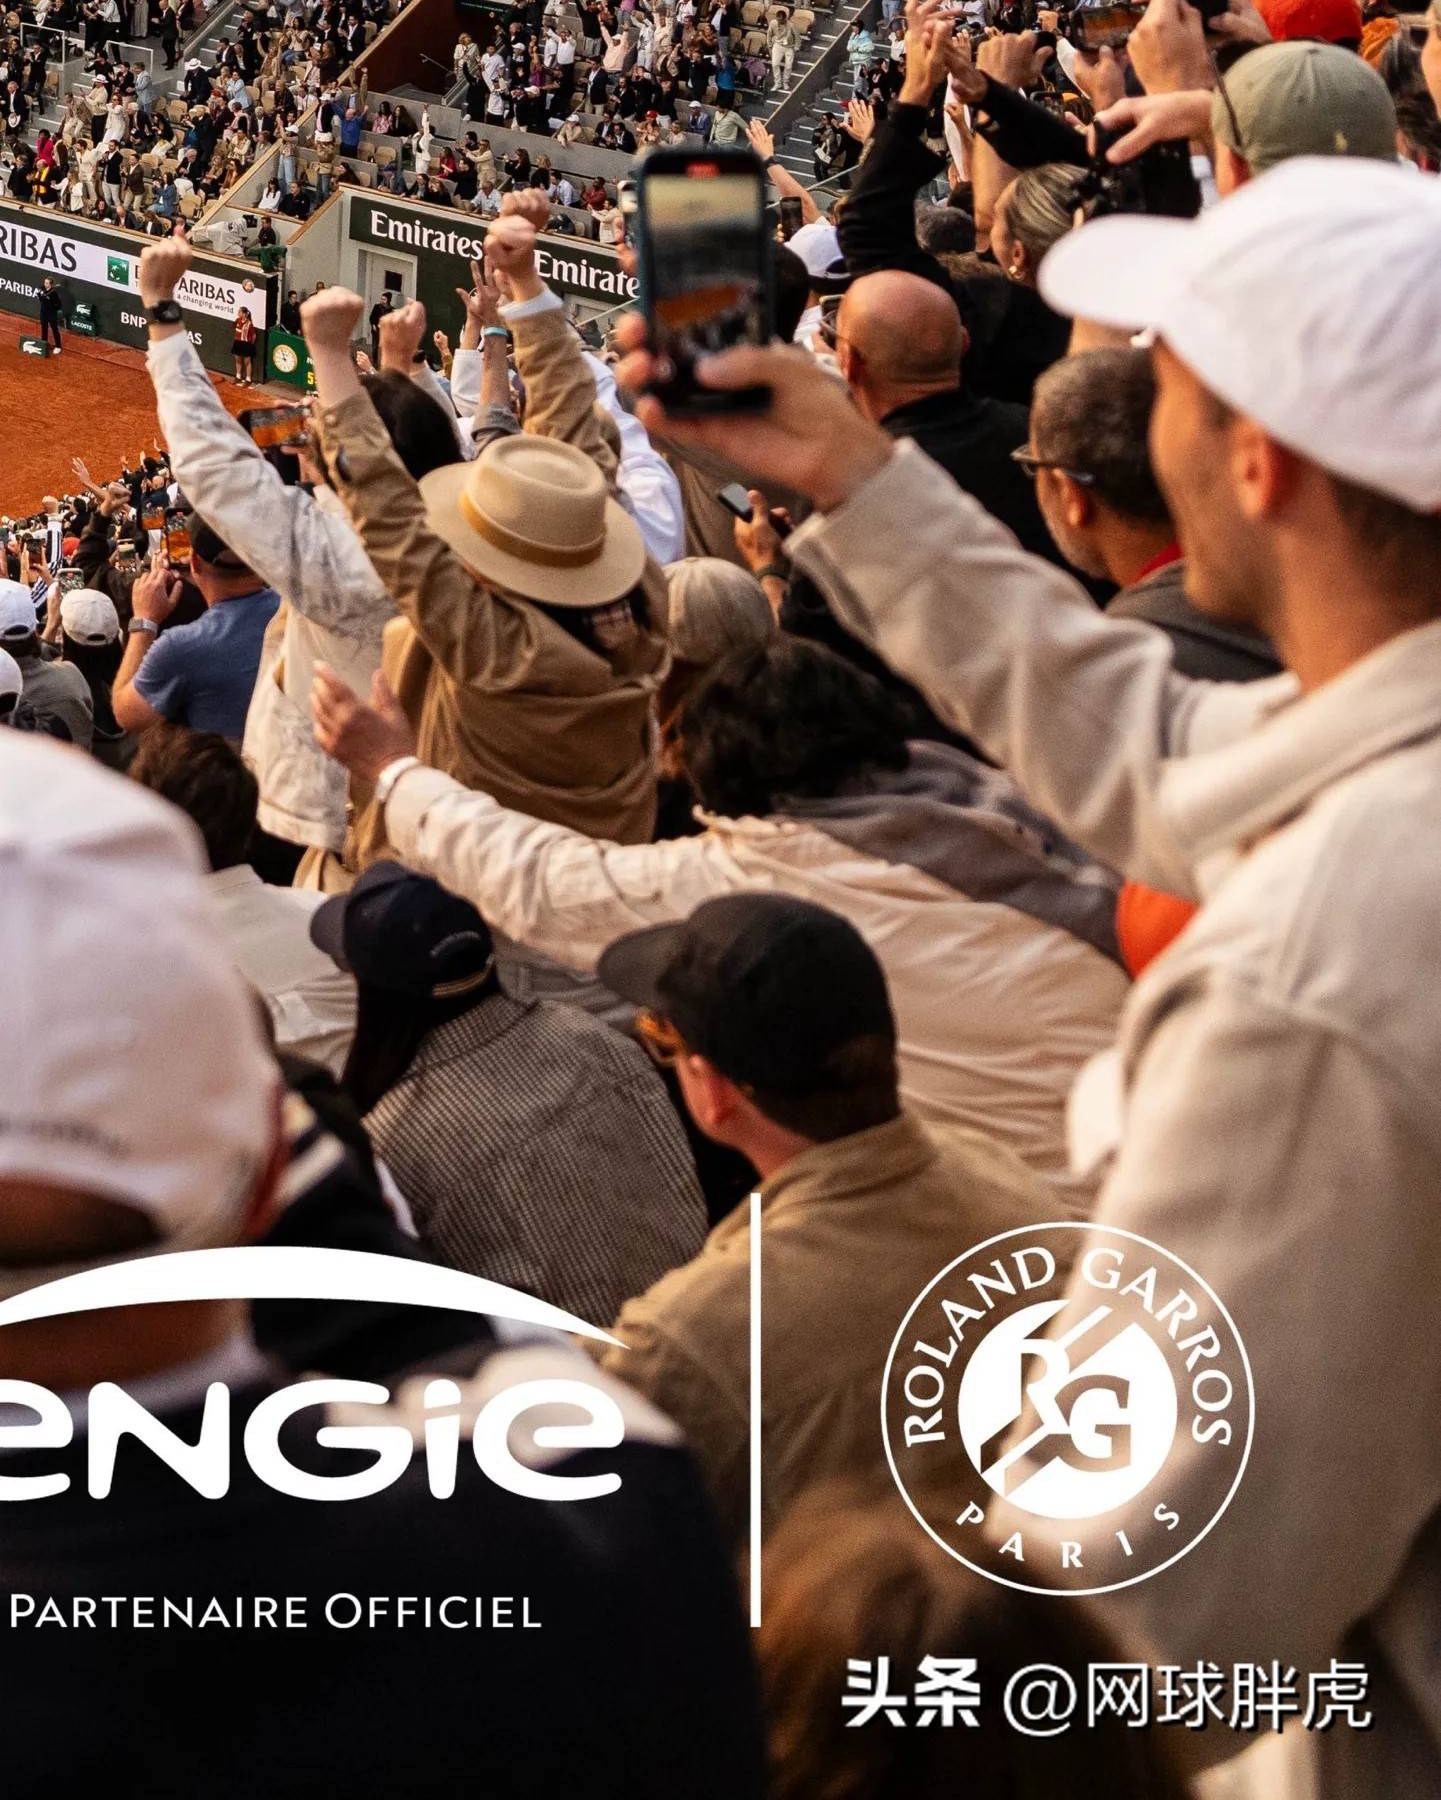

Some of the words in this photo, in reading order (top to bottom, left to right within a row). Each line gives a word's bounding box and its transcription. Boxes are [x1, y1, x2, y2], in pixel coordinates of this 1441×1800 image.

[370, 209, 483, 261] Emirates
[533, 249, 641, 299] Emirate
[177, 276, 236, 305] ARIBAS
[182, 295, 213, 311] changing
[215, 302, 234, 315] world
[120, 311, 148, 329] BNP
